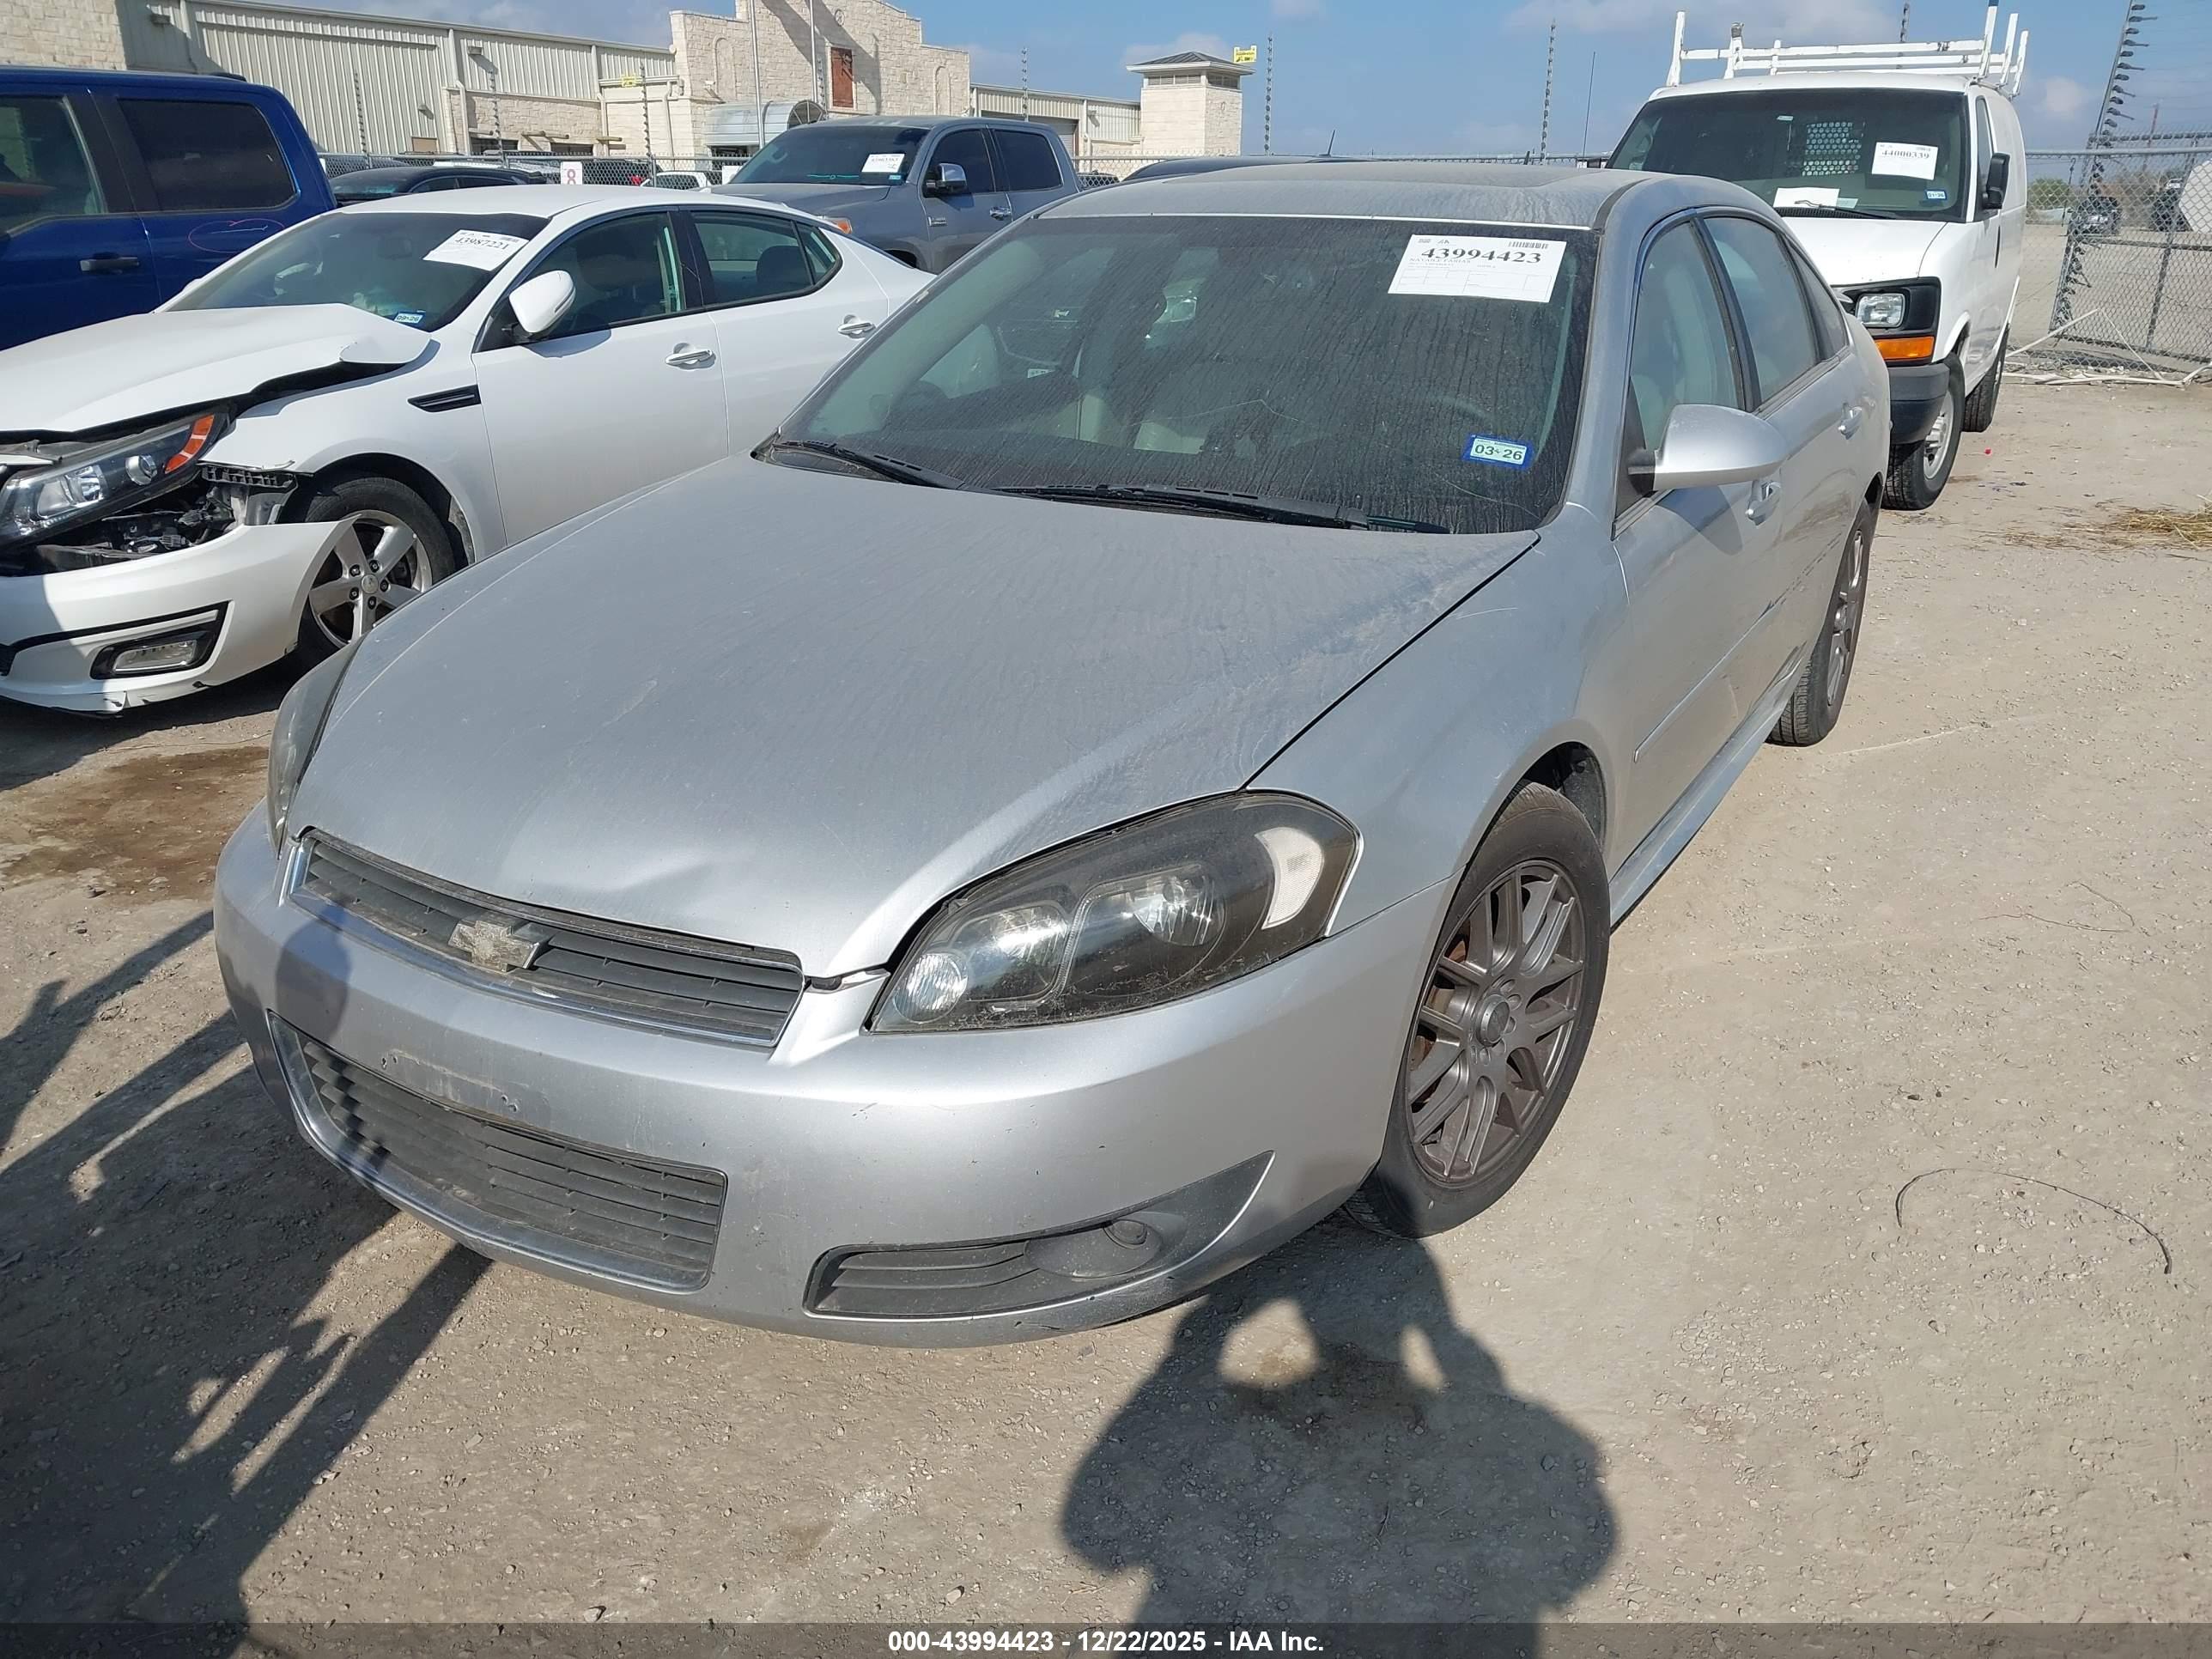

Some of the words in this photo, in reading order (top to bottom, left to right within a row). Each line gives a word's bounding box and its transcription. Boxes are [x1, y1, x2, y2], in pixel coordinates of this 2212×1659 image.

[1881, 149, 1930, 159] 44000339
[567, 168, 576, 185] 8
[454, 236, 509, 250] 43987221
[1421, 246, 1541, 264] 43994423
